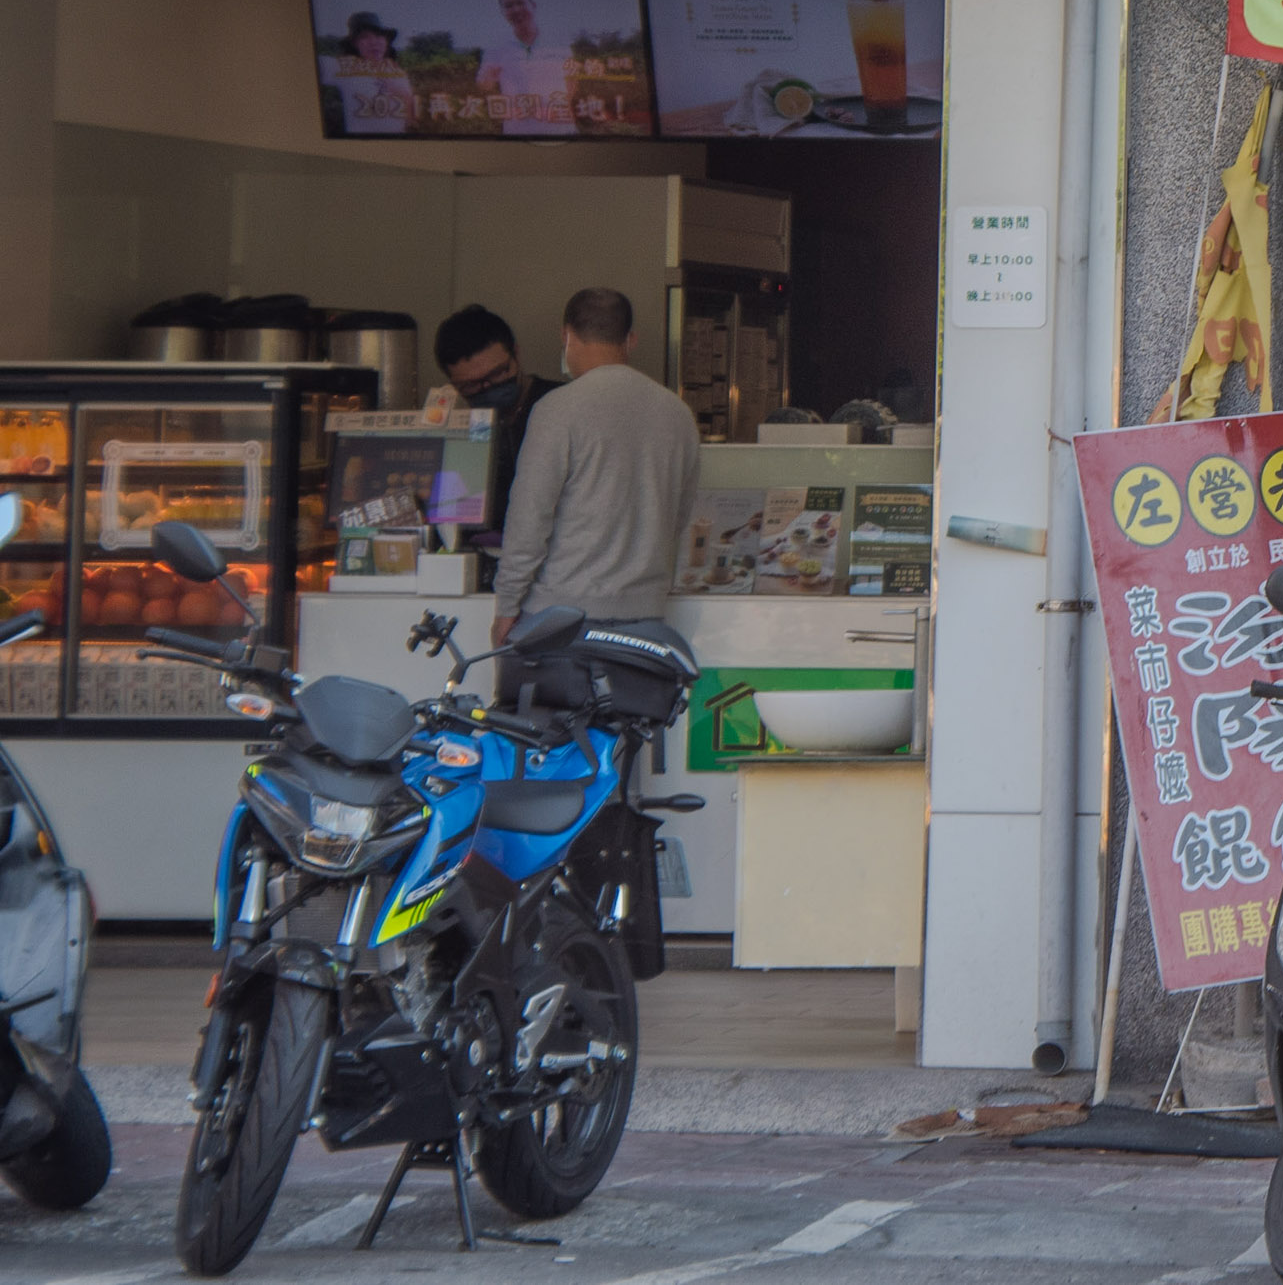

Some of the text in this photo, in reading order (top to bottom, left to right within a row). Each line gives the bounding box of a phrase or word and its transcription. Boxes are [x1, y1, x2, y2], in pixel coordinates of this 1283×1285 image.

[1185, 543, 1251, 574] 創立於
[1125, 585, 1191, 805] 菜市仔嬤
